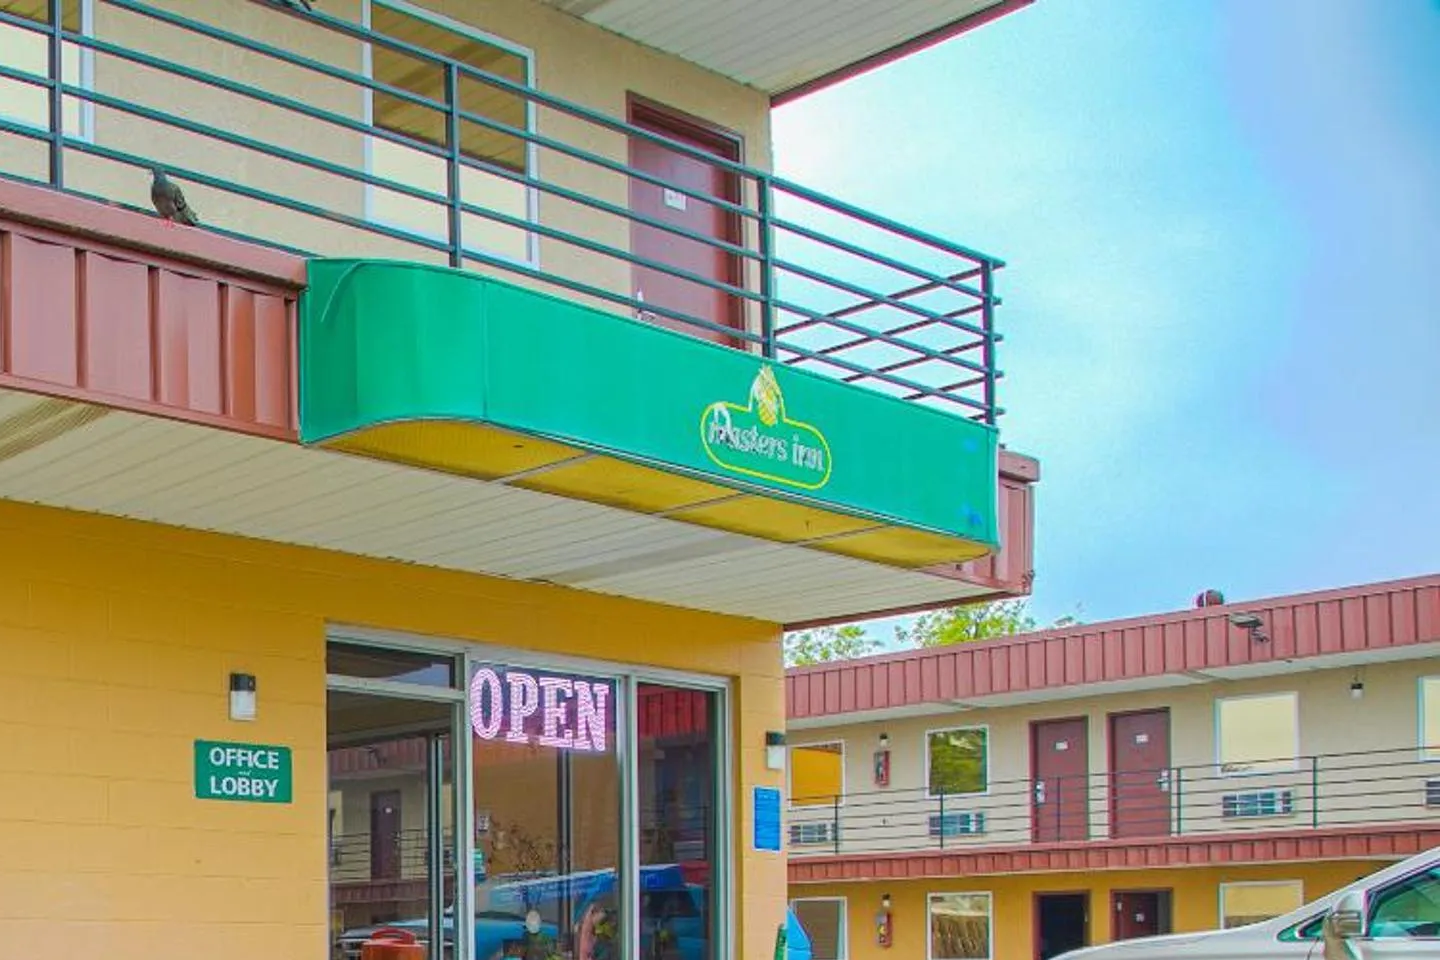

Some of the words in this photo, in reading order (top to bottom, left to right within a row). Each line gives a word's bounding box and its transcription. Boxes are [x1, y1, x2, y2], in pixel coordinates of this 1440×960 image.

[470, 668, 609, 751] OPEN
[209, 747, 280, 769] OFFICE
[210, 776, 279, 797] LOBBY
